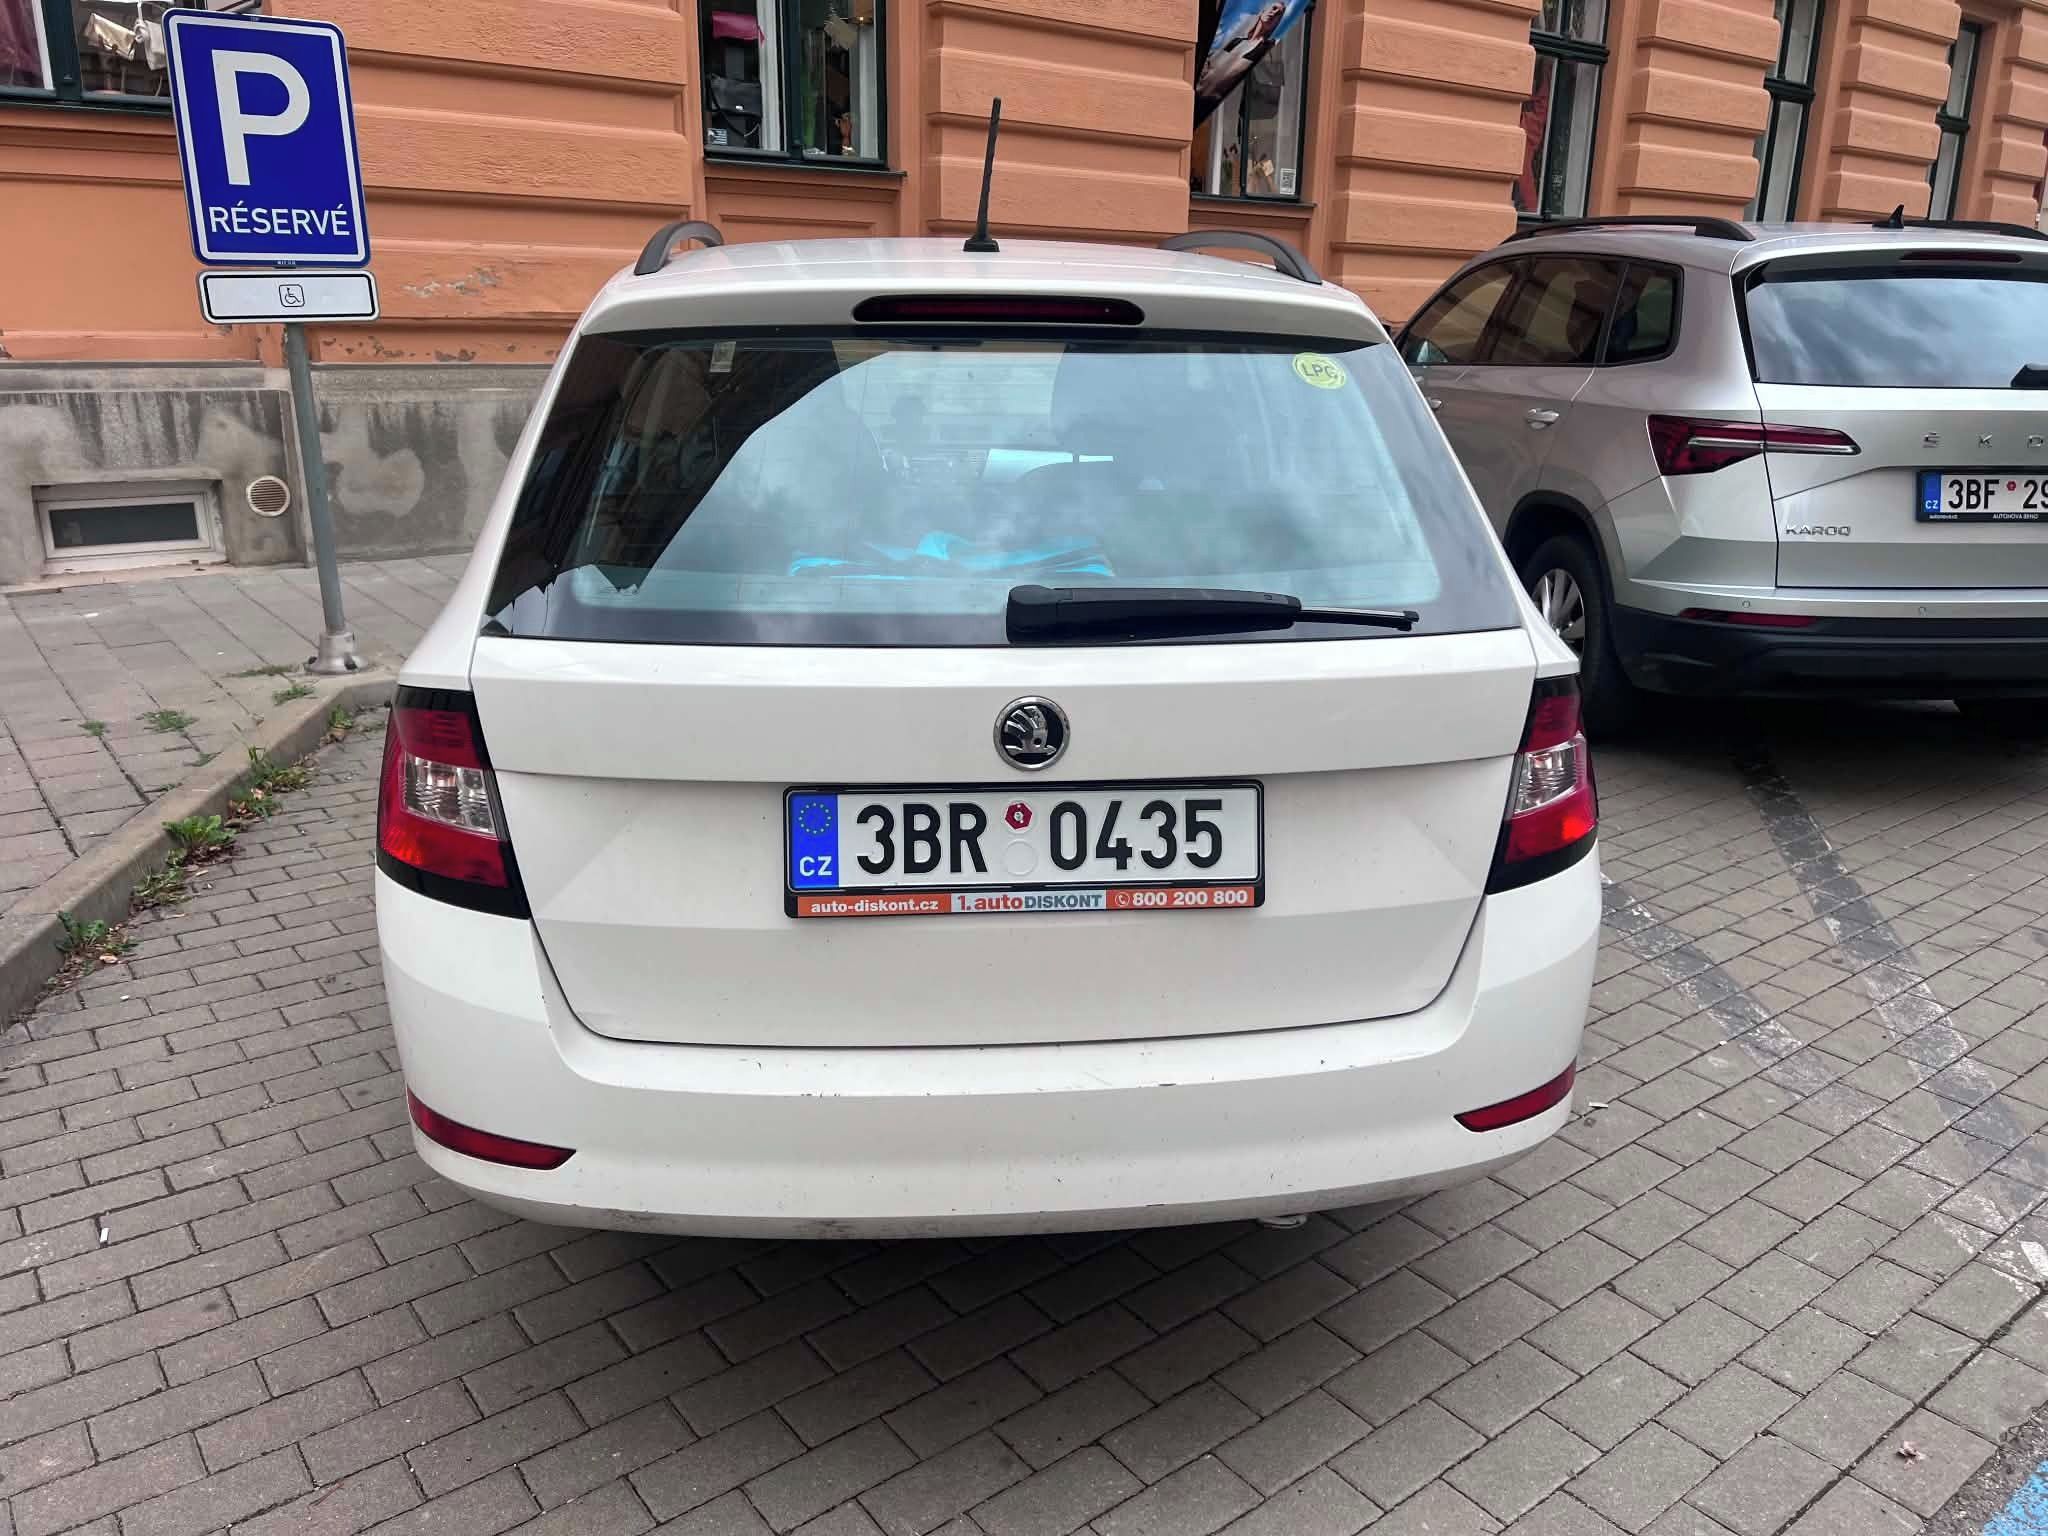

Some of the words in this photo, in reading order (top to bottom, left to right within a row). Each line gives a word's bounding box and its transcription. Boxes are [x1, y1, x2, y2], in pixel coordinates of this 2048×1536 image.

[211, 49, 311, 186] P
[208, 200, 350, 236] RÉSERVÉ
[1301, 363, 1339, 379] LPG
[1925, 500, 1939, 509] CZ
[1948, 479, 2000, 509] 3BF
[1785, 524, 1852, 537] KAROQ
[856, 803, 988, 875] 3BR
[1049, 799, 1223, 871] 0435
[799, 855, 832, 877] CZ
[811, 898, 939, 914] auto-diskont.cz
[1132, 892, 1168, 906] 800
[1172, 891, 1208, 905] 200
[1213, 890, 1249, 904] 800
